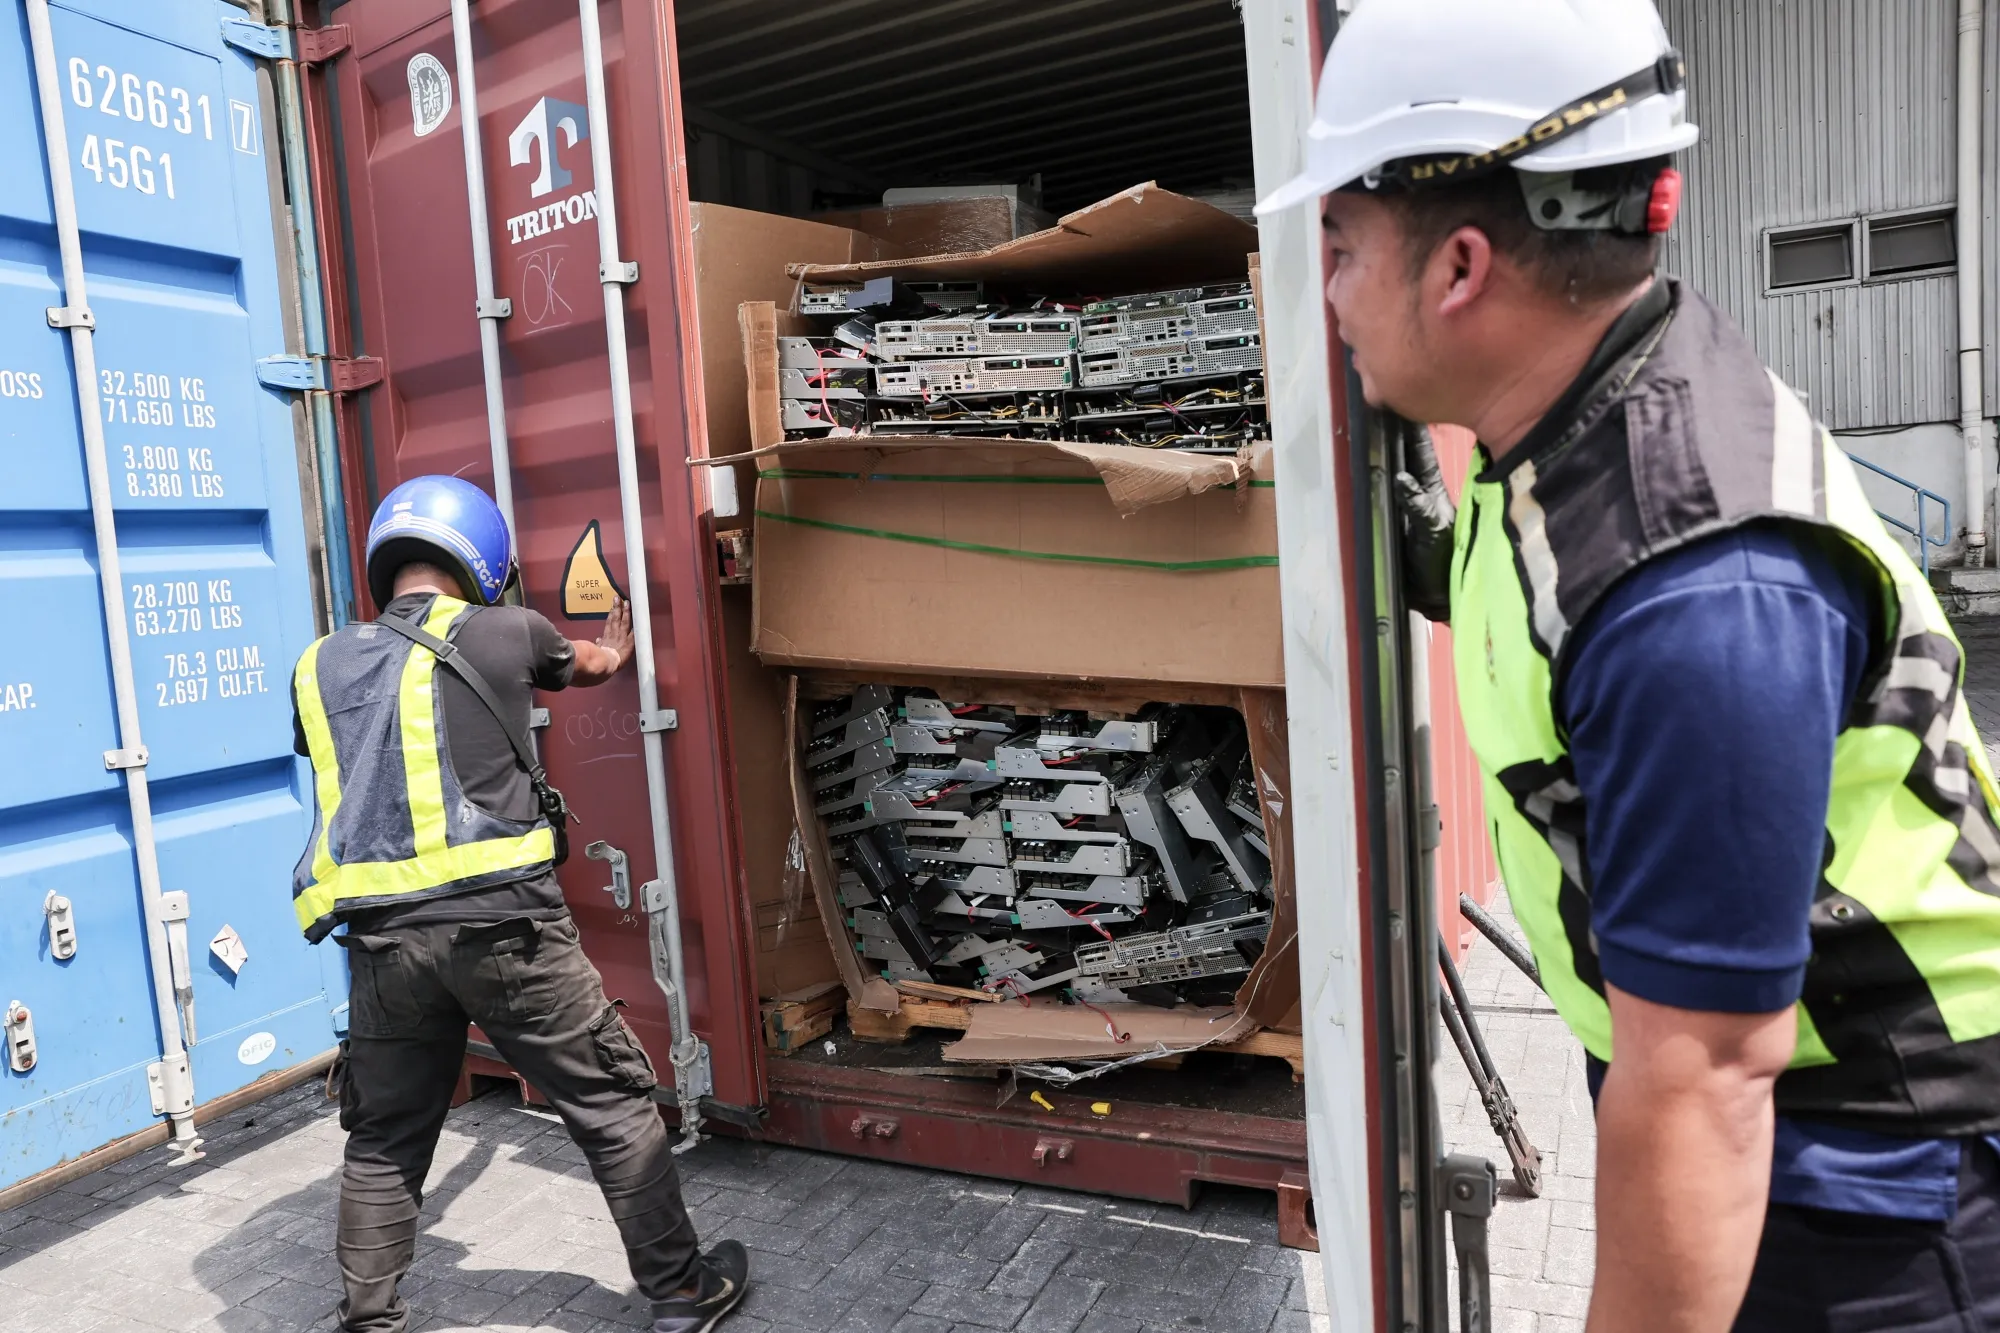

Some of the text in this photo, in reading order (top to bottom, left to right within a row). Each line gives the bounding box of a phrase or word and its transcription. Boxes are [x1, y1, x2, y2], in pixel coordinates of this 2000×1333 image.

[69, 57, 250, 149] 626631 7
[81, 134, 175, 200] 45G1
[507, 189, 598, 244] TRITON
[180, 376, 206, 402] KG
[183, 403, 216, 429] LBS
[187, 447, 213, 472] KG
[191, 474, 224, 498] LBS
[208, 579, 232, 604] KG
[576, 579, 600, 588] SUPER
[579, 592, 603, 601] HEAVY
[210, 604, 242, 630] LBS
[164, 645, 265, 679] 76.3 CU.M.
[218, 670, 269, 698] CU.FT.
